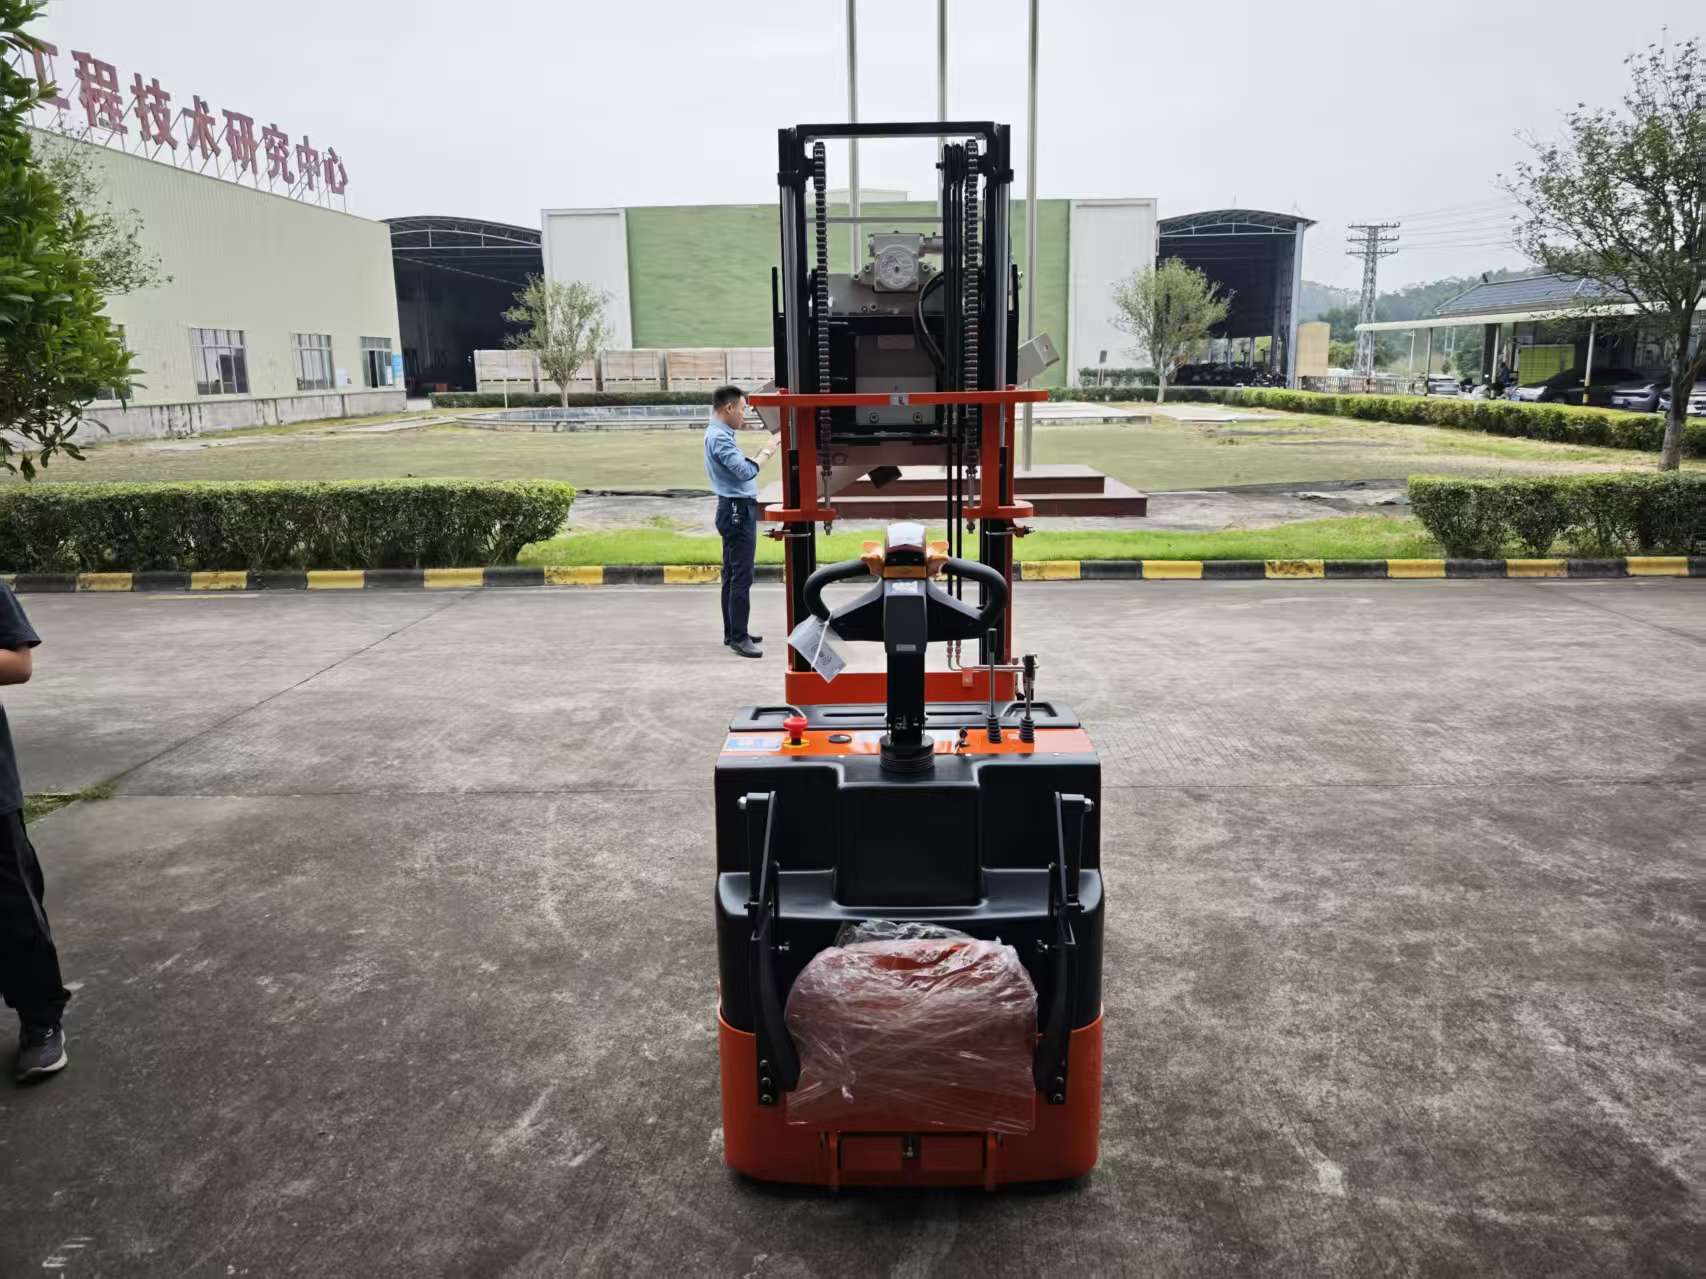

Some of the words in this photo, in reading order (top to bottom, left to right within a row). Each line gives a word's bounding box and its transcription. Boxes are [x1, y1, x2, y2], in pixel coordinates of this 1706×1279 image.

[13, 32, 348, 195] 工程技术研究中心
